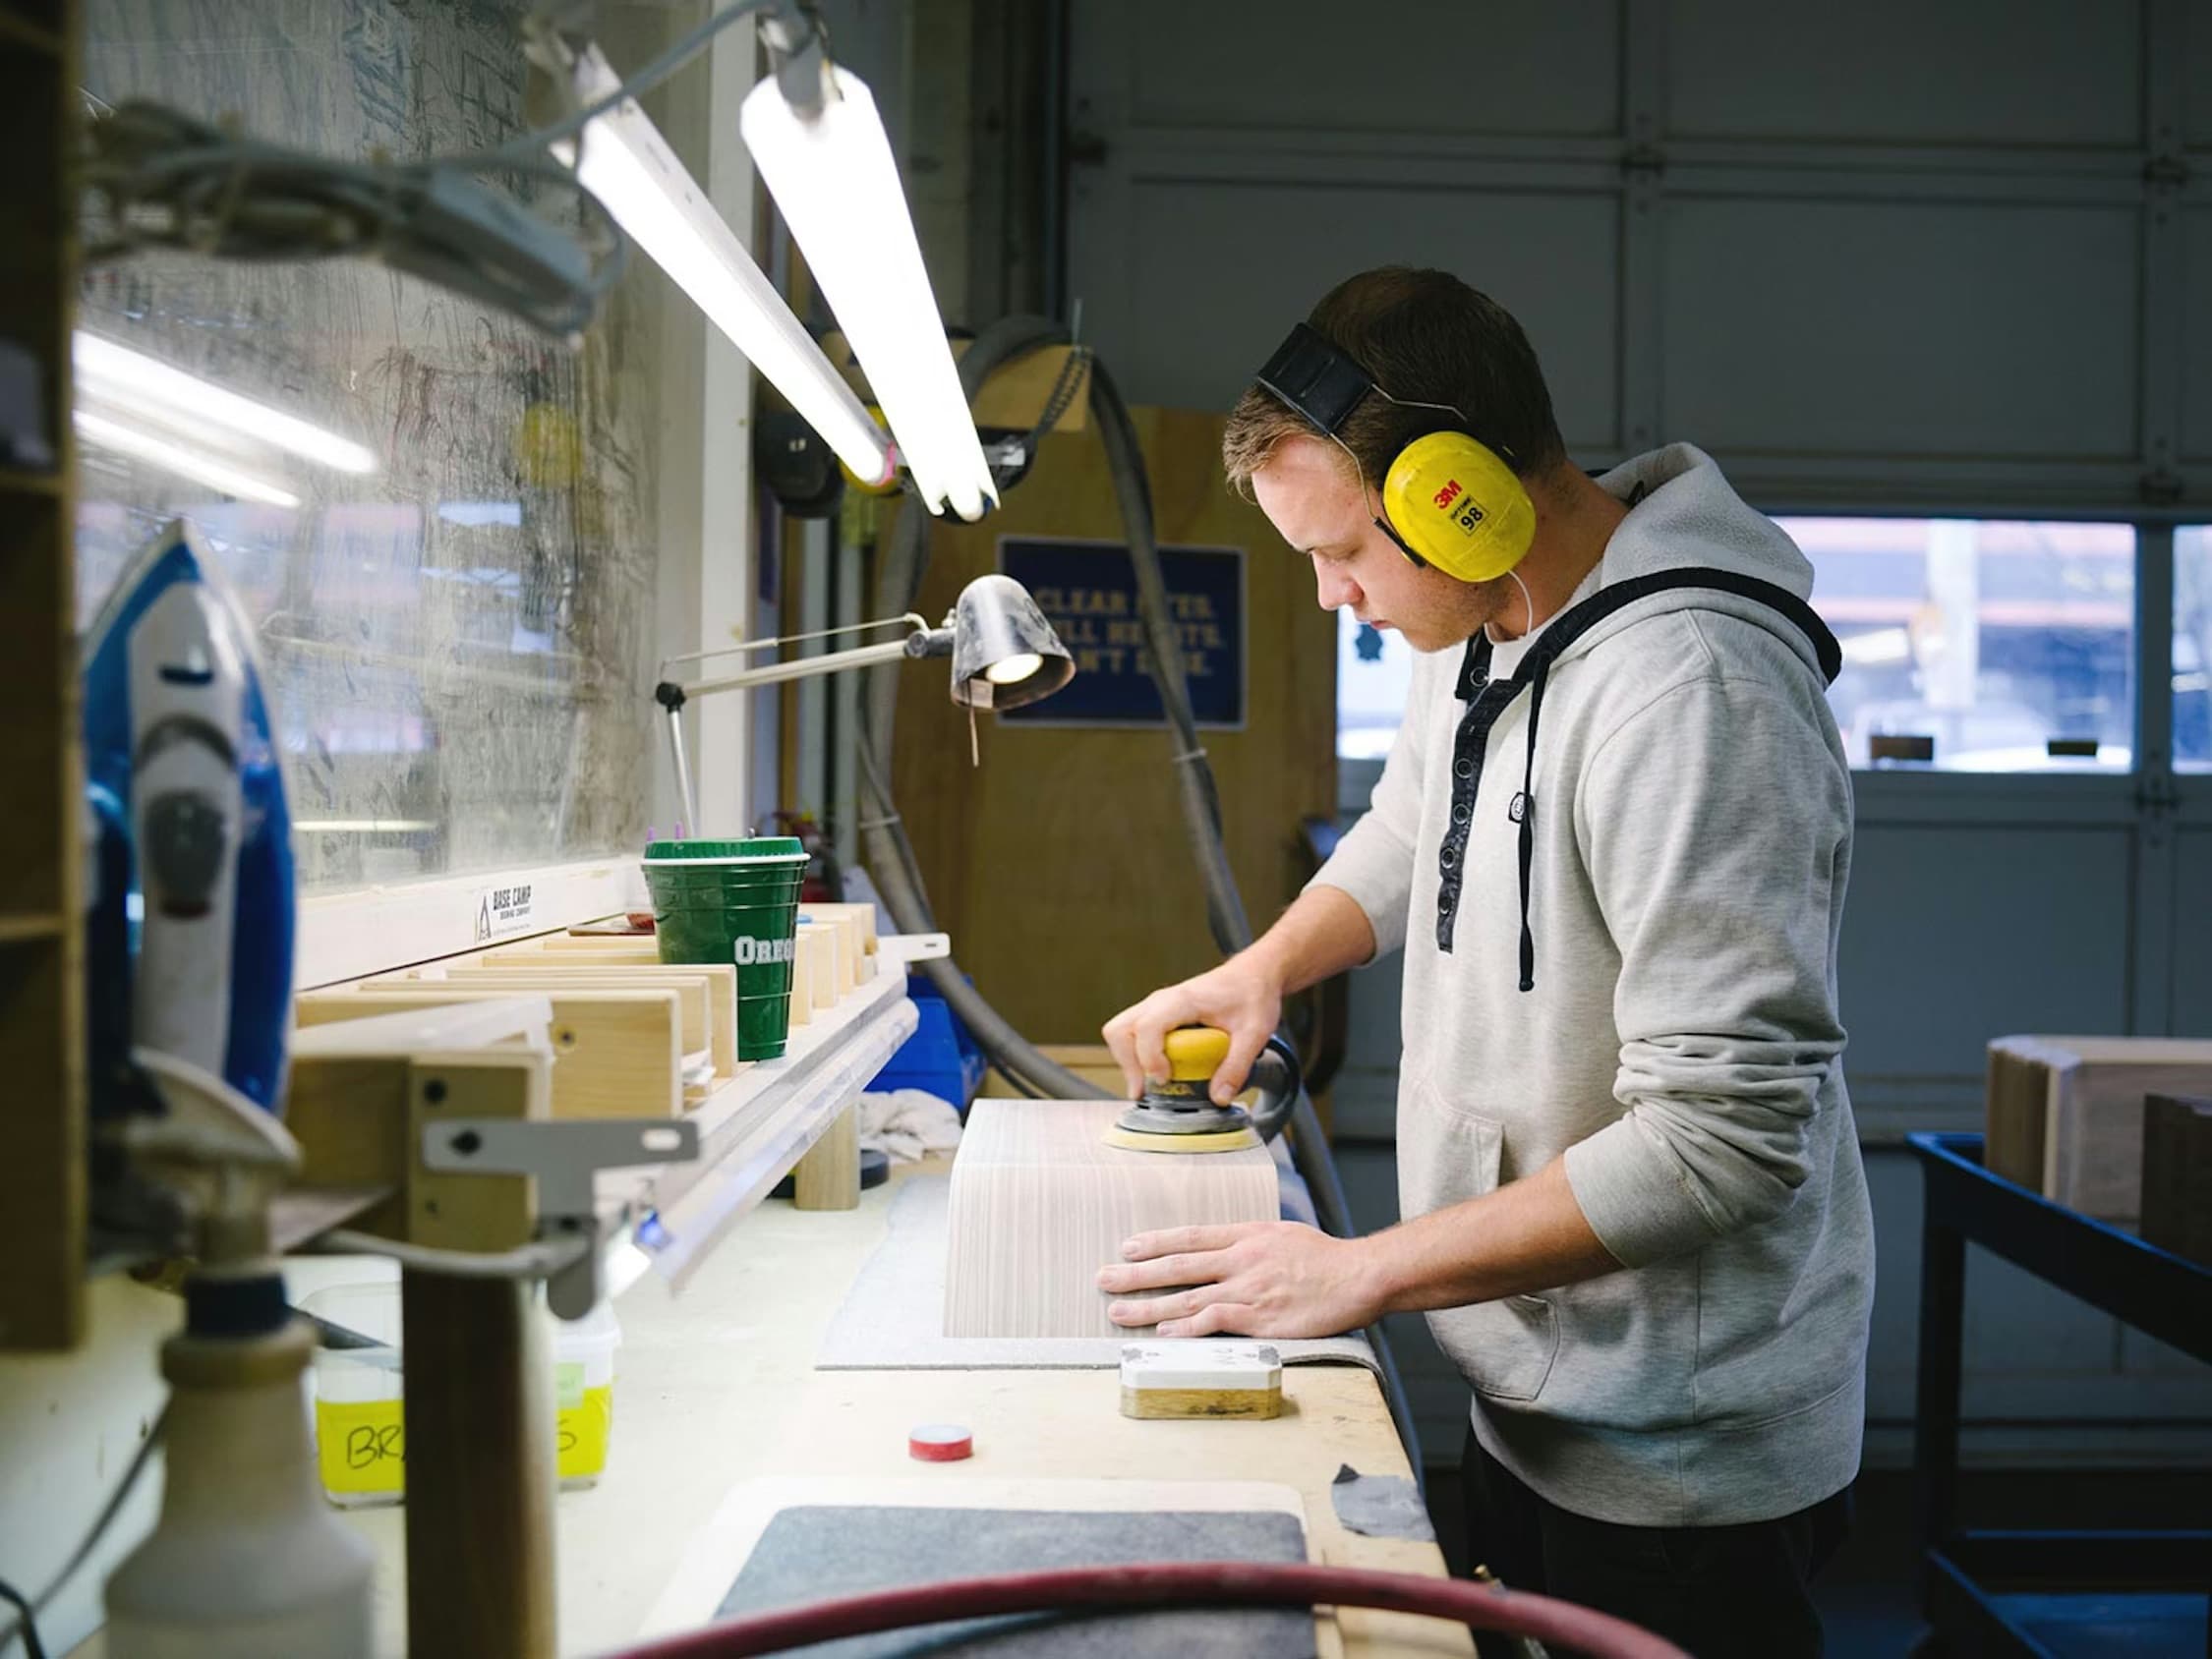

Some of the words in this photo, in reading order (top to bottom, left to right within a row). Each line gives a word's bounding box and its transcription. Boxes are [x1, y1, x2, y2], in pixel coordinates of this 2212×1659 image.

[1433, 479, 1463, 509] 3M
[1460, 507, 1483, 531] 98
[494, 888, 510, 910] BASE
[512, 885, 531, 906] CAMP
